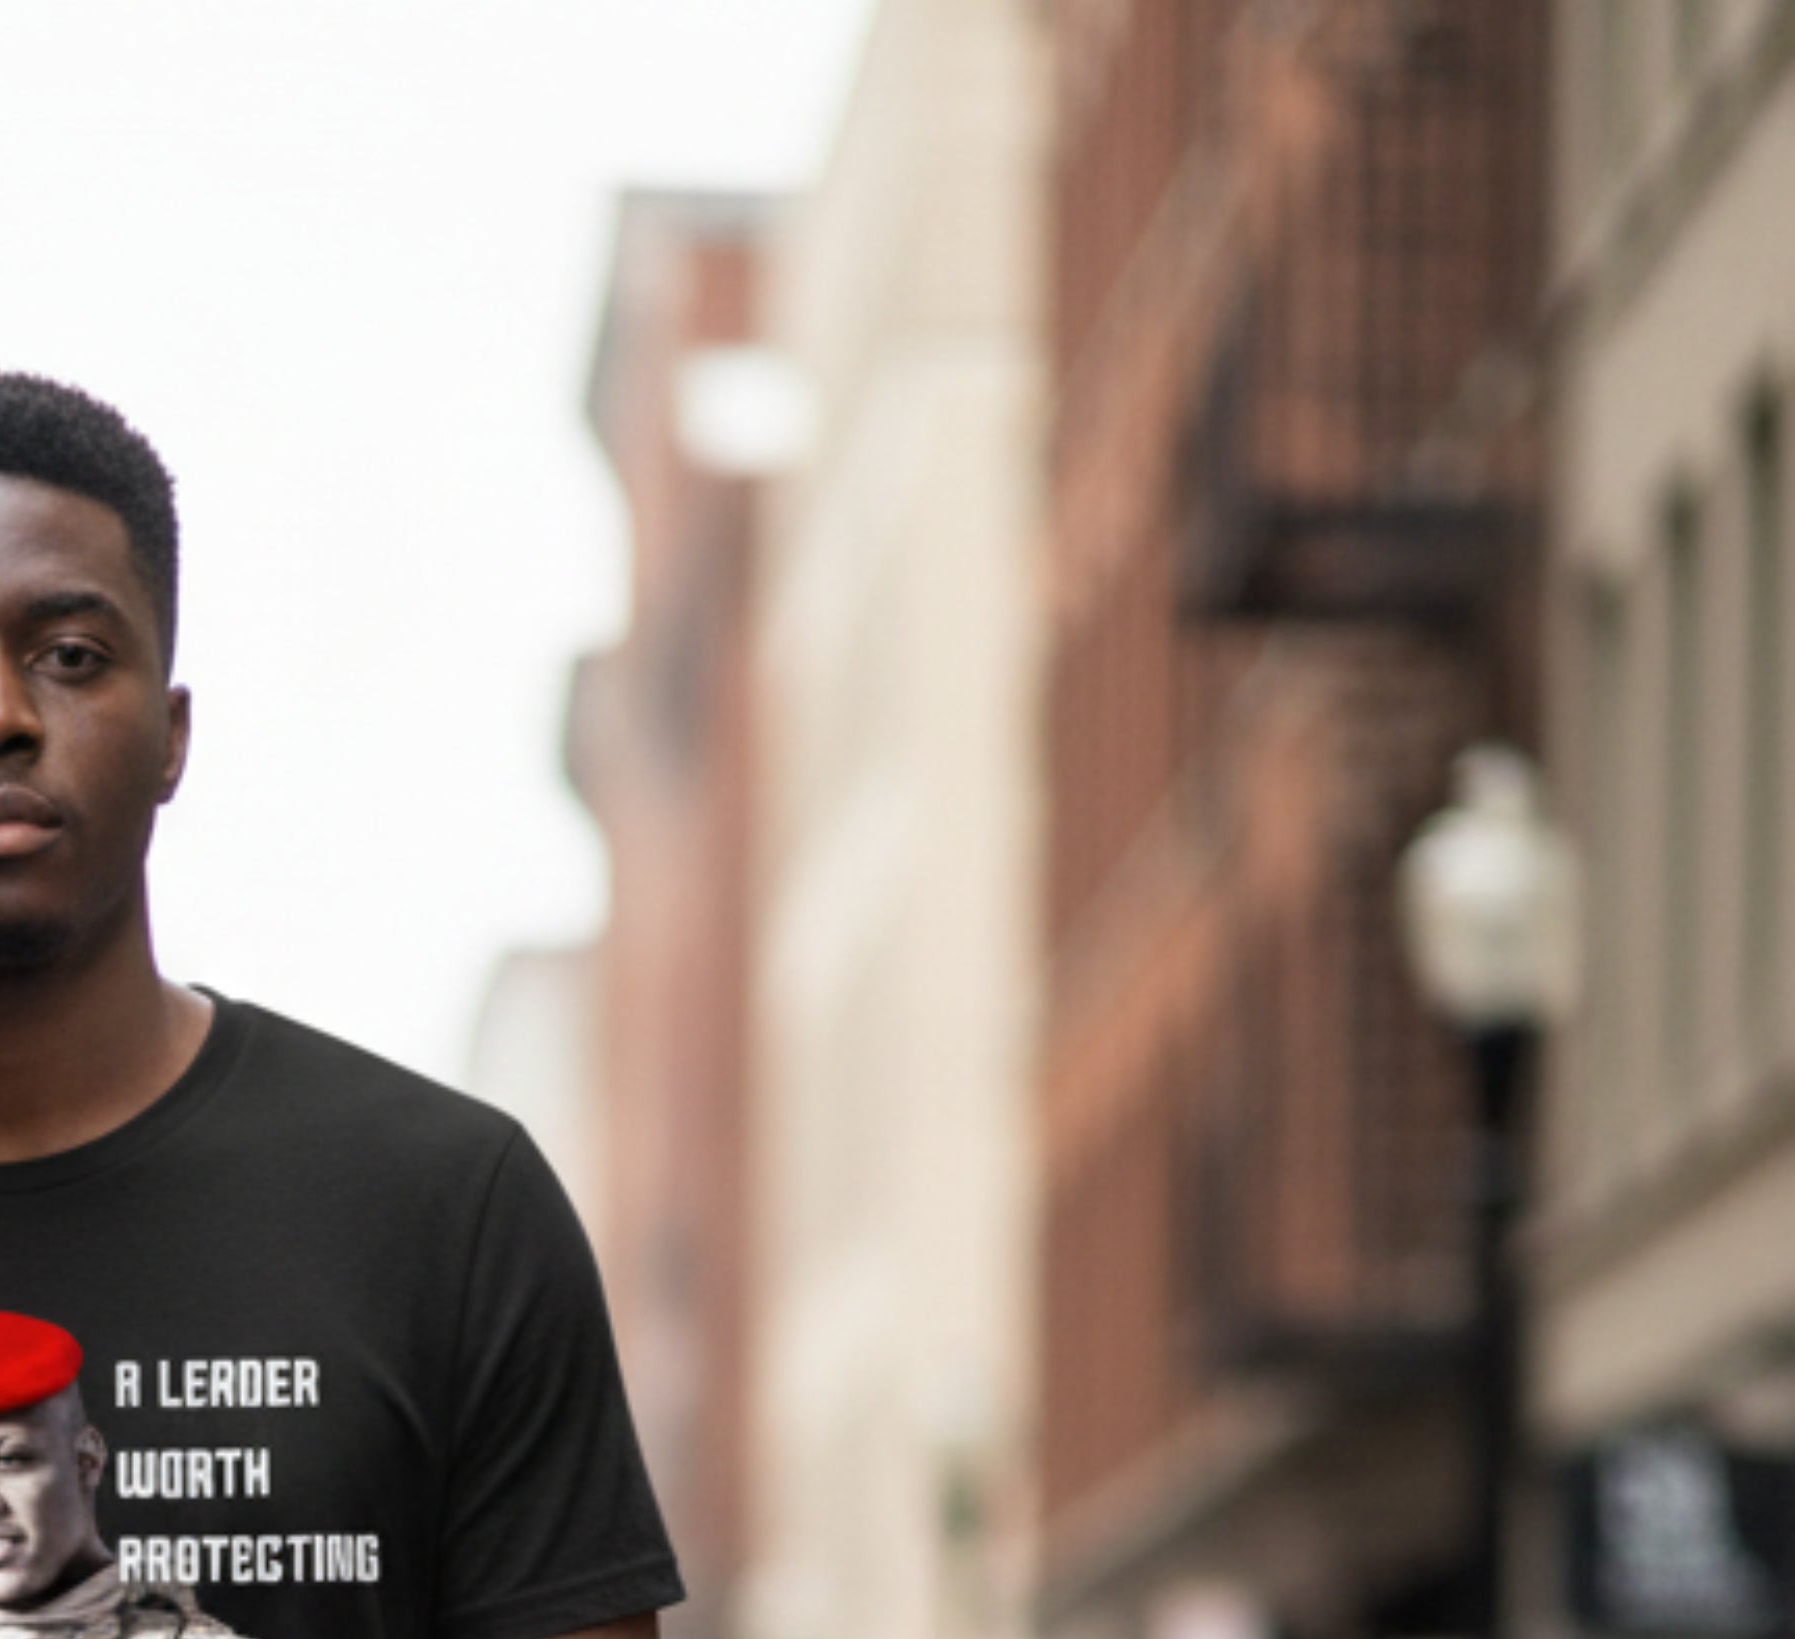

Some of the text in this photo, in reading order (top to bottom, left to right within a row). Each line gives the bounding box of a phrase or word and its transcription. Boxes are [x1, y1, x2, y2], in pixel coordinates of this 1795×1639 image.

[114, 1358, 321, 1408] A LEADER
[115, 1448, 271, 1499] WORTH
